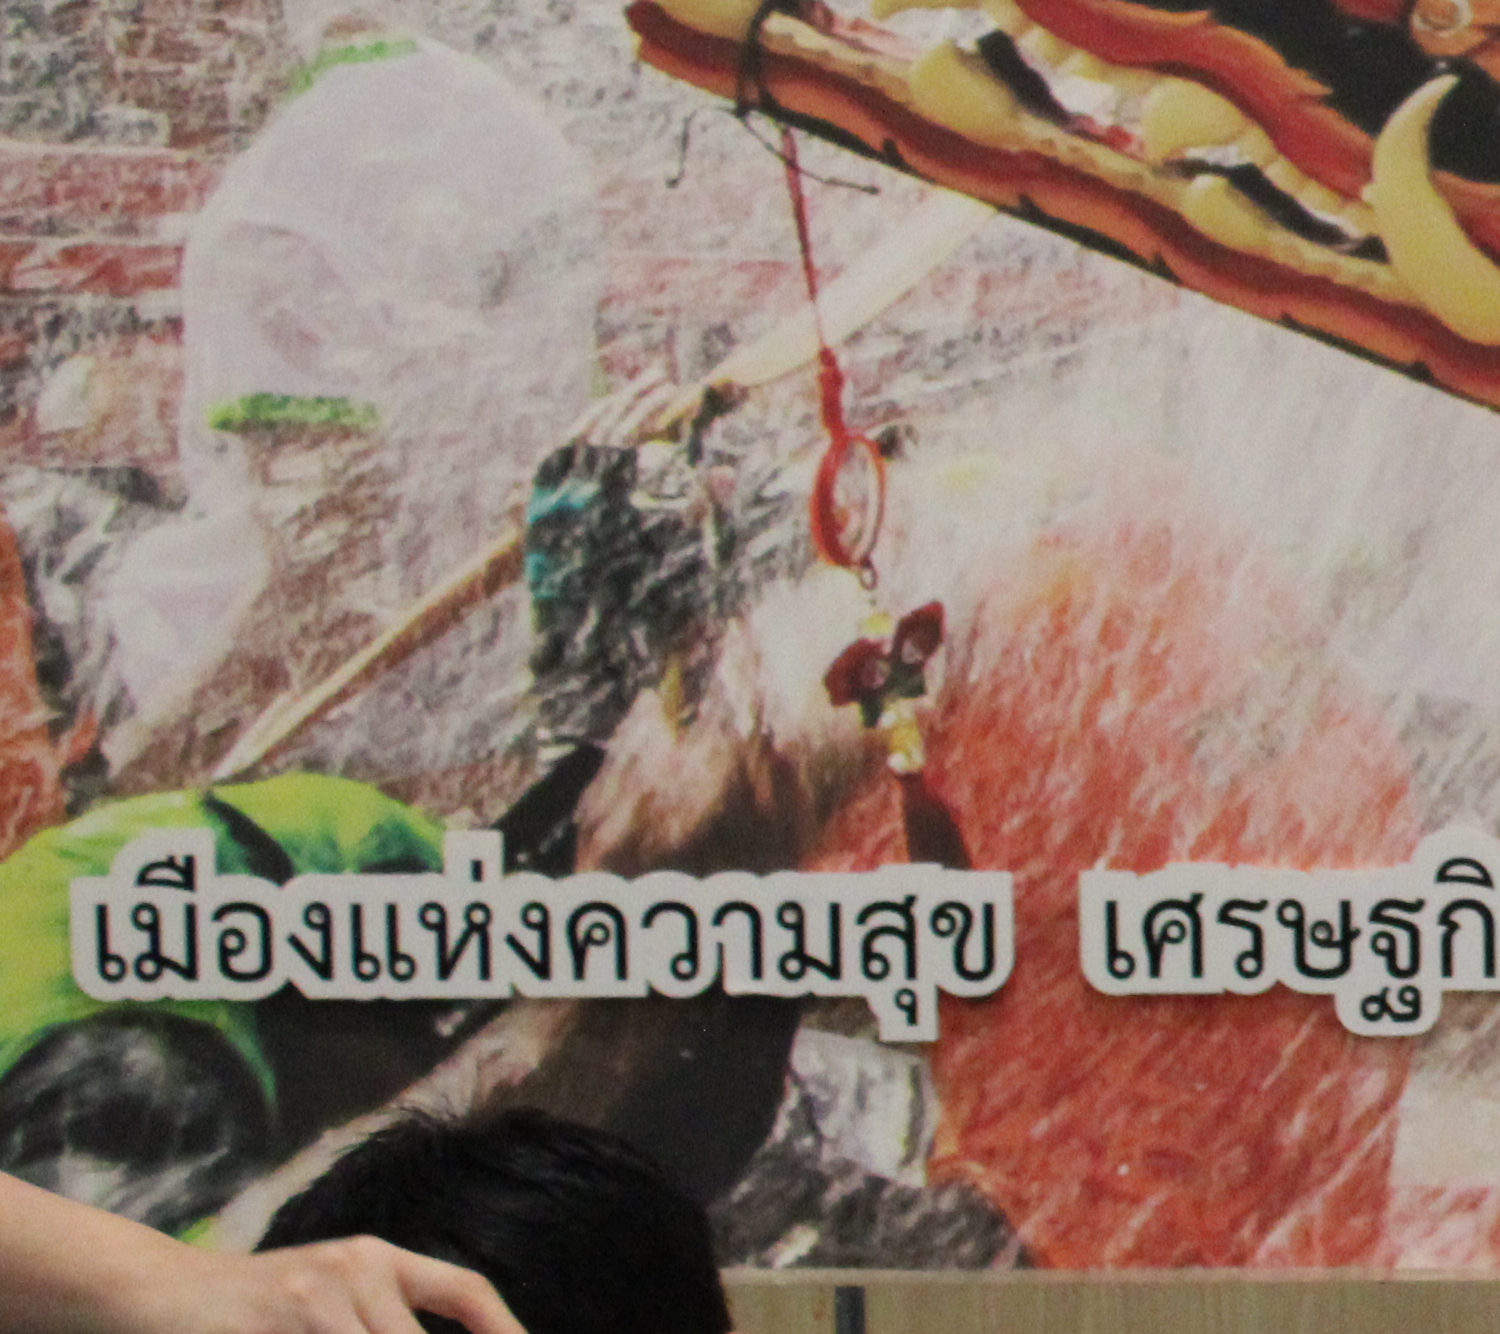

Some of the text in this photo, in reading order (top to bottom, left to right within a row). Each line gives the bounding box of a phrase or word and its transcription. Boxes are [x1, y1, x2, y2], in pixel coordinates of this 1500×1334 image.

[94, 852, 998, 1028] เมืองแห่งความสุข
